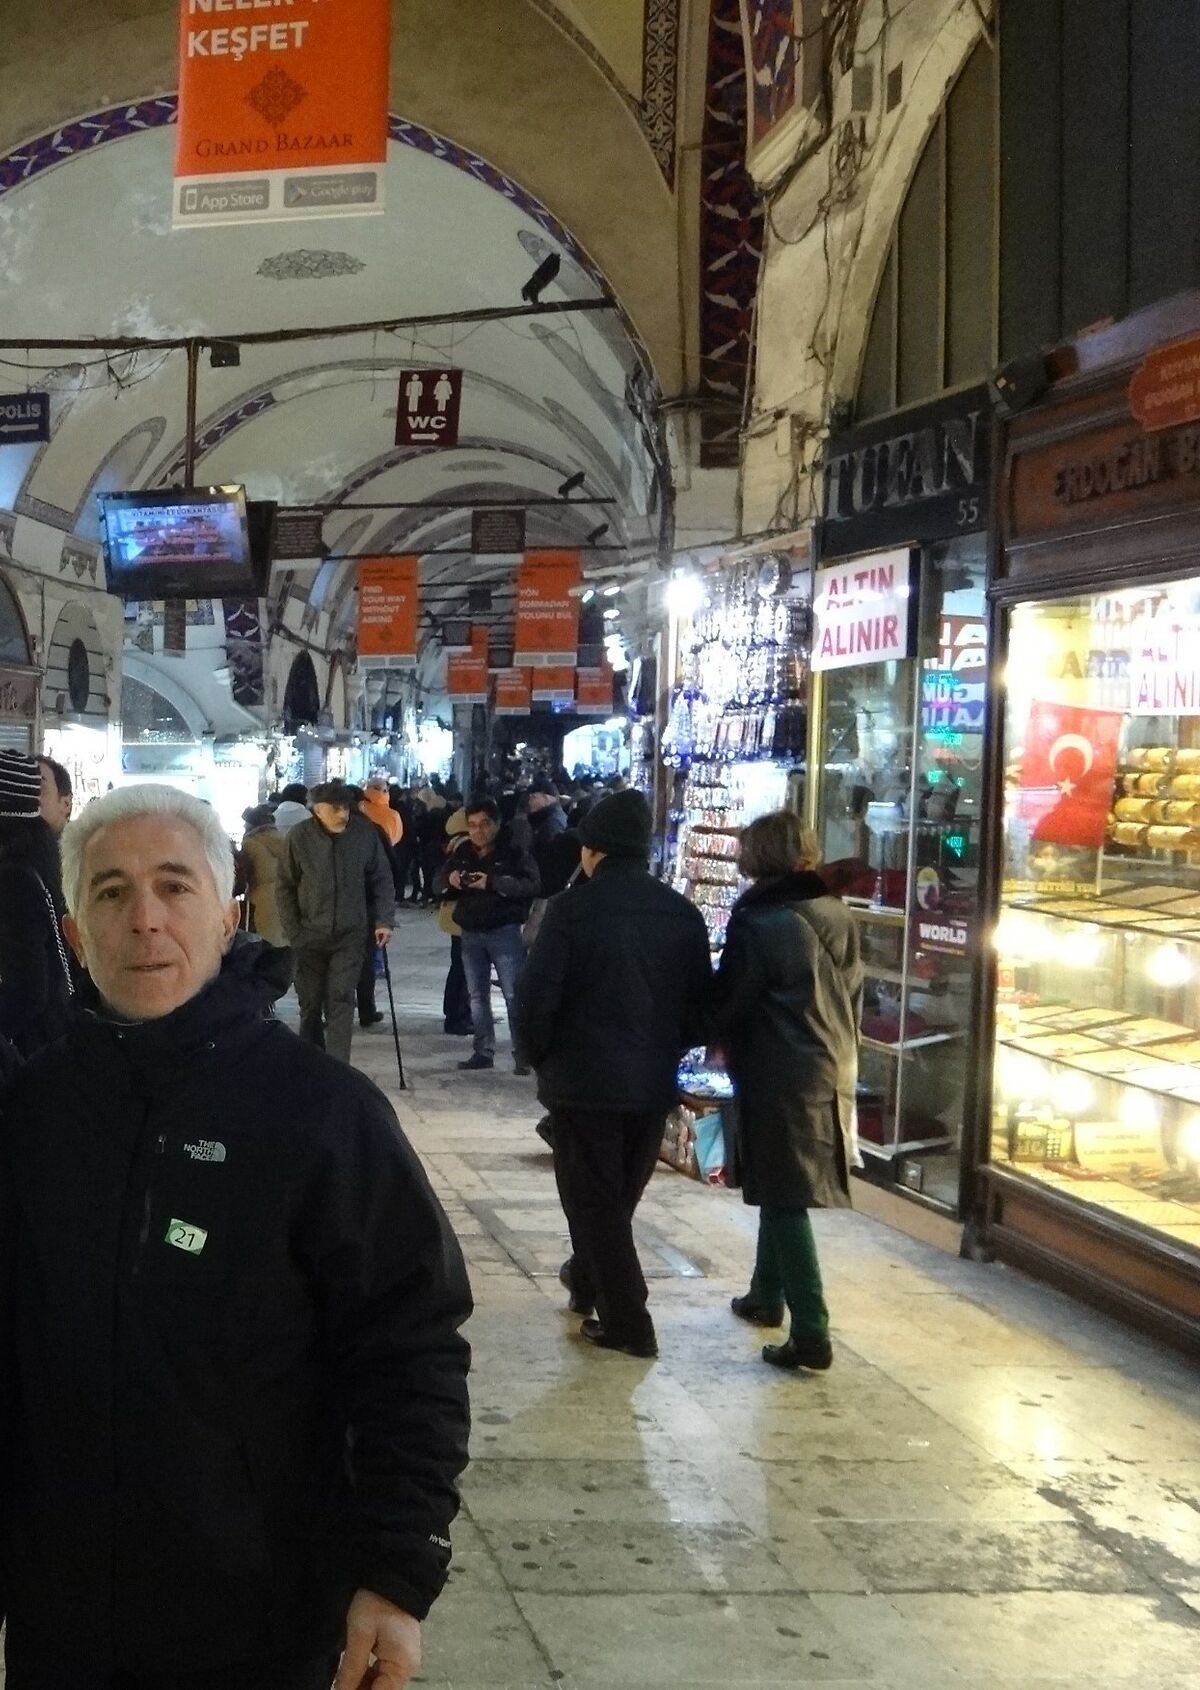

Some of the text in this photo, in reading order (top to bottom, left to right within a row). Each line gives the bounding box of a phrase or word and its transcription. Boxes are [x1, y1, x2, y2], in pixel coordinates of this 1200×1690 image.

[187, 20, 309, 61] KEŞFET
[201, 191, 265, 211] App Store
[310, 186, 351, 199] Google
[407, 416, 448, 430] WC
[956, 499, 980, 526] 55
[826, 564, 894, 611] ALTIN
[820, 614, 899, 658] ALINIR
[919, 922, 968, 945] WORLD
[198, 1139, 216, 1149] THE
[174, 1226, 196, 1248] 21
